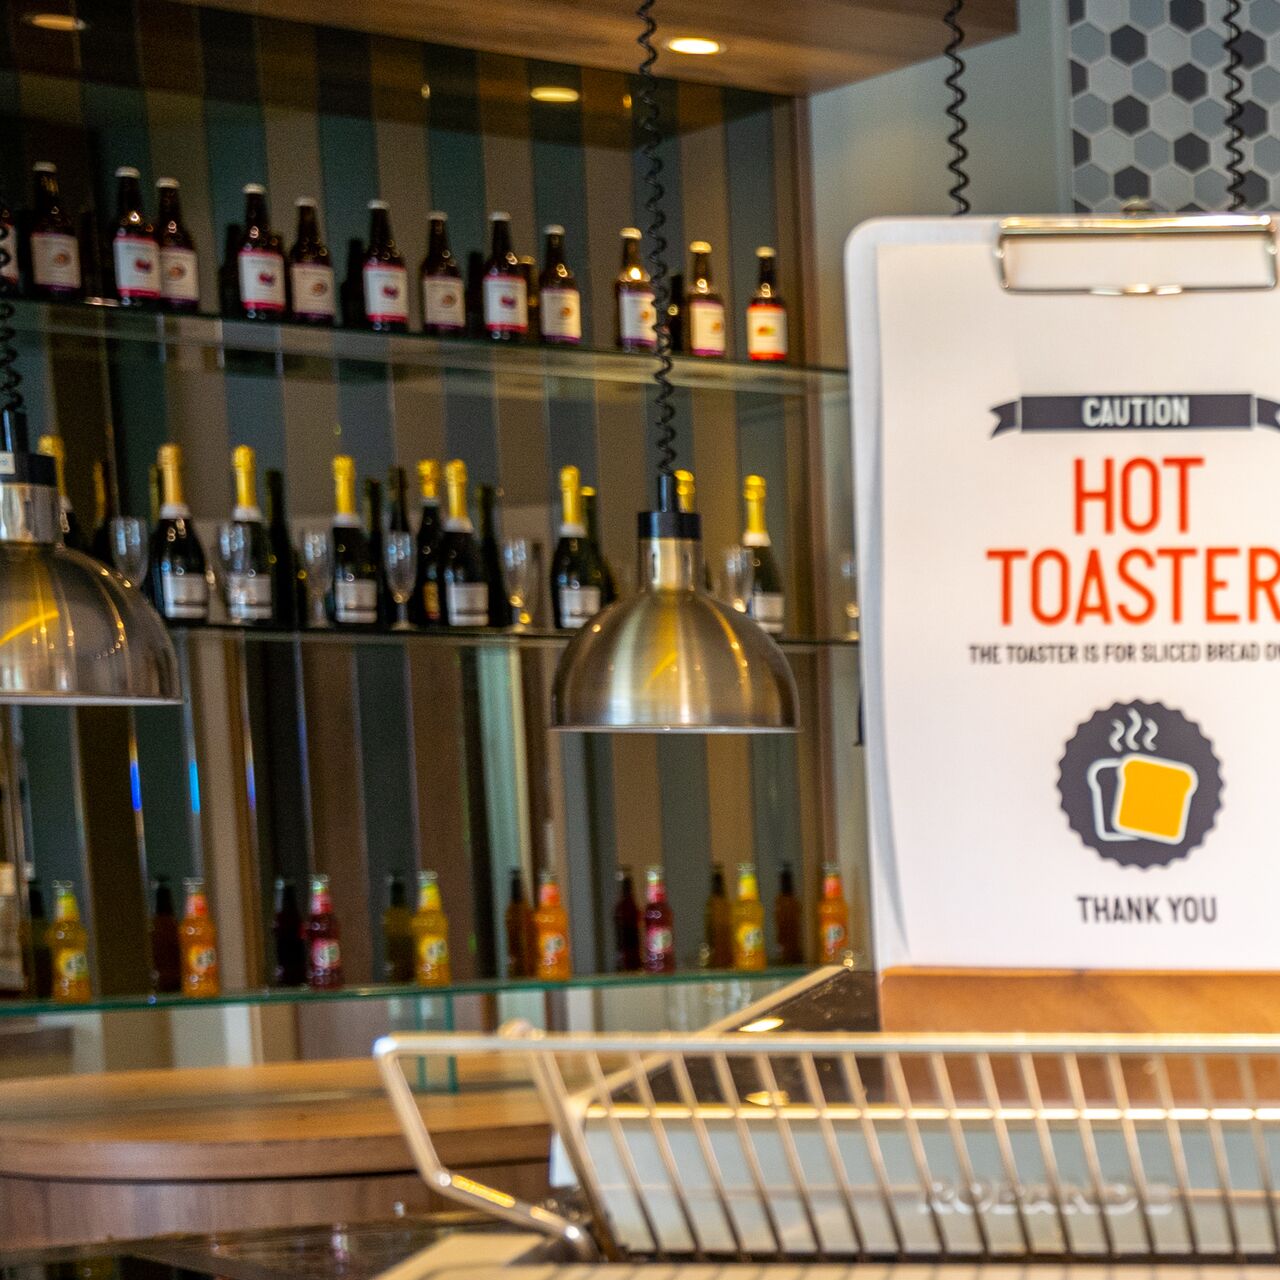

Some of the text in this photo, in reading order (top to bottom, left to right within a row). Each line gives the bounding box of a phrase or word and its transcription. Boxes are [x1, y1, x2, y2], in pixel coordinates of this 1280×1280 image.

[1080, 397, 1190, 428] CAUTION
[1072, 456, 1205, 535] HOT
[969, 643, 1001, 664] THE
[1006, 643, 1079, 664] TOASTER
[1083, 643, 1101, 663] IS
[1104, 643, 1137, 663] FOR
[1141, 643, 1201, 663] SLICED
[1205, 642, 1261, 662] BREAD
[1076, 896, 1219, 925] THANK YOU
